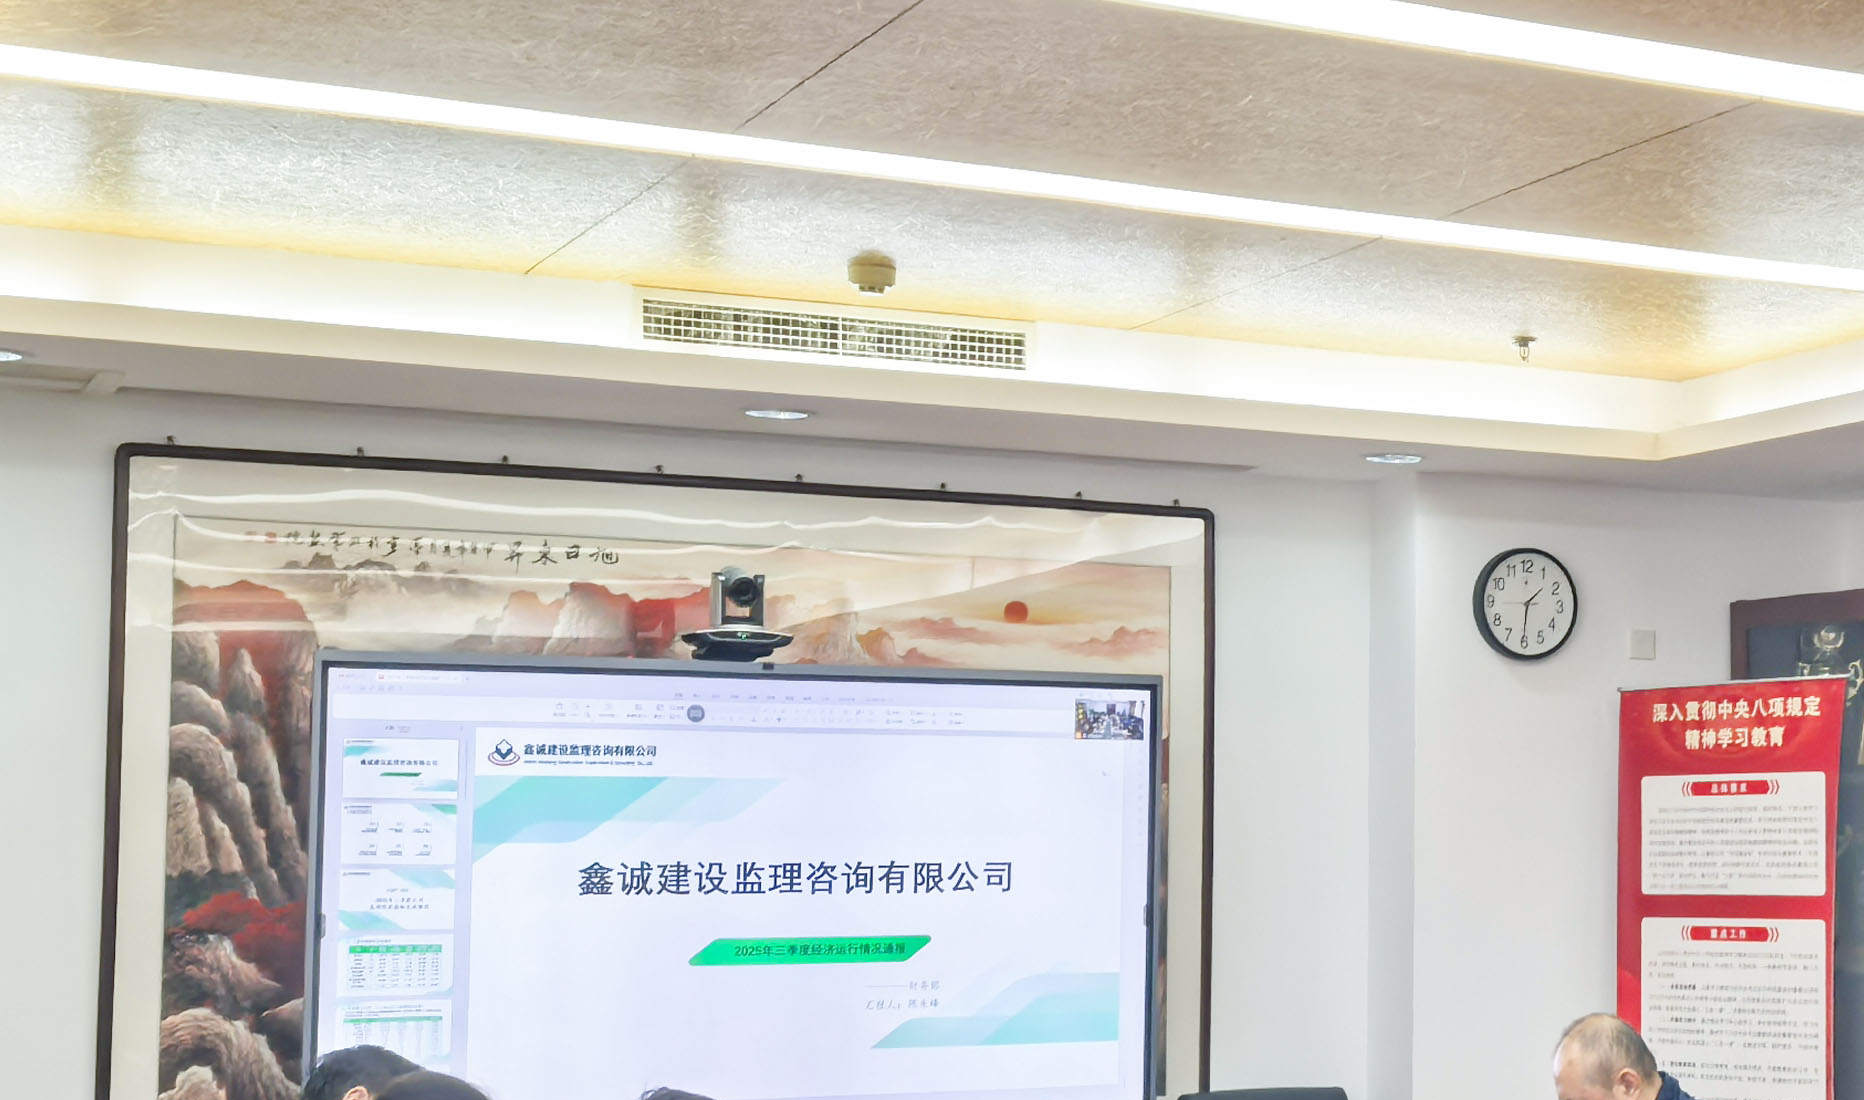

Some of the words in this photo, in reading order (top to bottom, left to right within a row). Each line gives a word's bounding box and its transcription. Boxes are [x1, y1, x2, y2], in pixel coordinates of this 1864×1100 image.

[1506, 563, 1517, 577] 11
[1520, 559, 1534, 574] 12
[1540, 566, 1547, 580] 1
[1493, 577, 1505, 591] 10
[1551, 581, 1560, 596] 2
[1486, 594, 1495, 609] 9
[1555, 599, 1564, 614] 3
[1493, 612, 1502, 627] 8
[1548, 617, 1556, 632] 4
[1504, 627, 1513, 642] 7
[1536, 630, 1545, 645] 5
[1520, 635, 1529, 650] 6
[1652, 695, 1822, 724] 深入贯彻中央八项规定
[1684, 726, 1786, 751] 精神学习教育
[523, 743, 657, 757] 鑫诚建设监理咨询有限公司
[577, 860, 1015, 898] 鑫诚建设监理咨询有限公司
[733, 941, 908, 958] 2025年三季度经济运行情况通报
